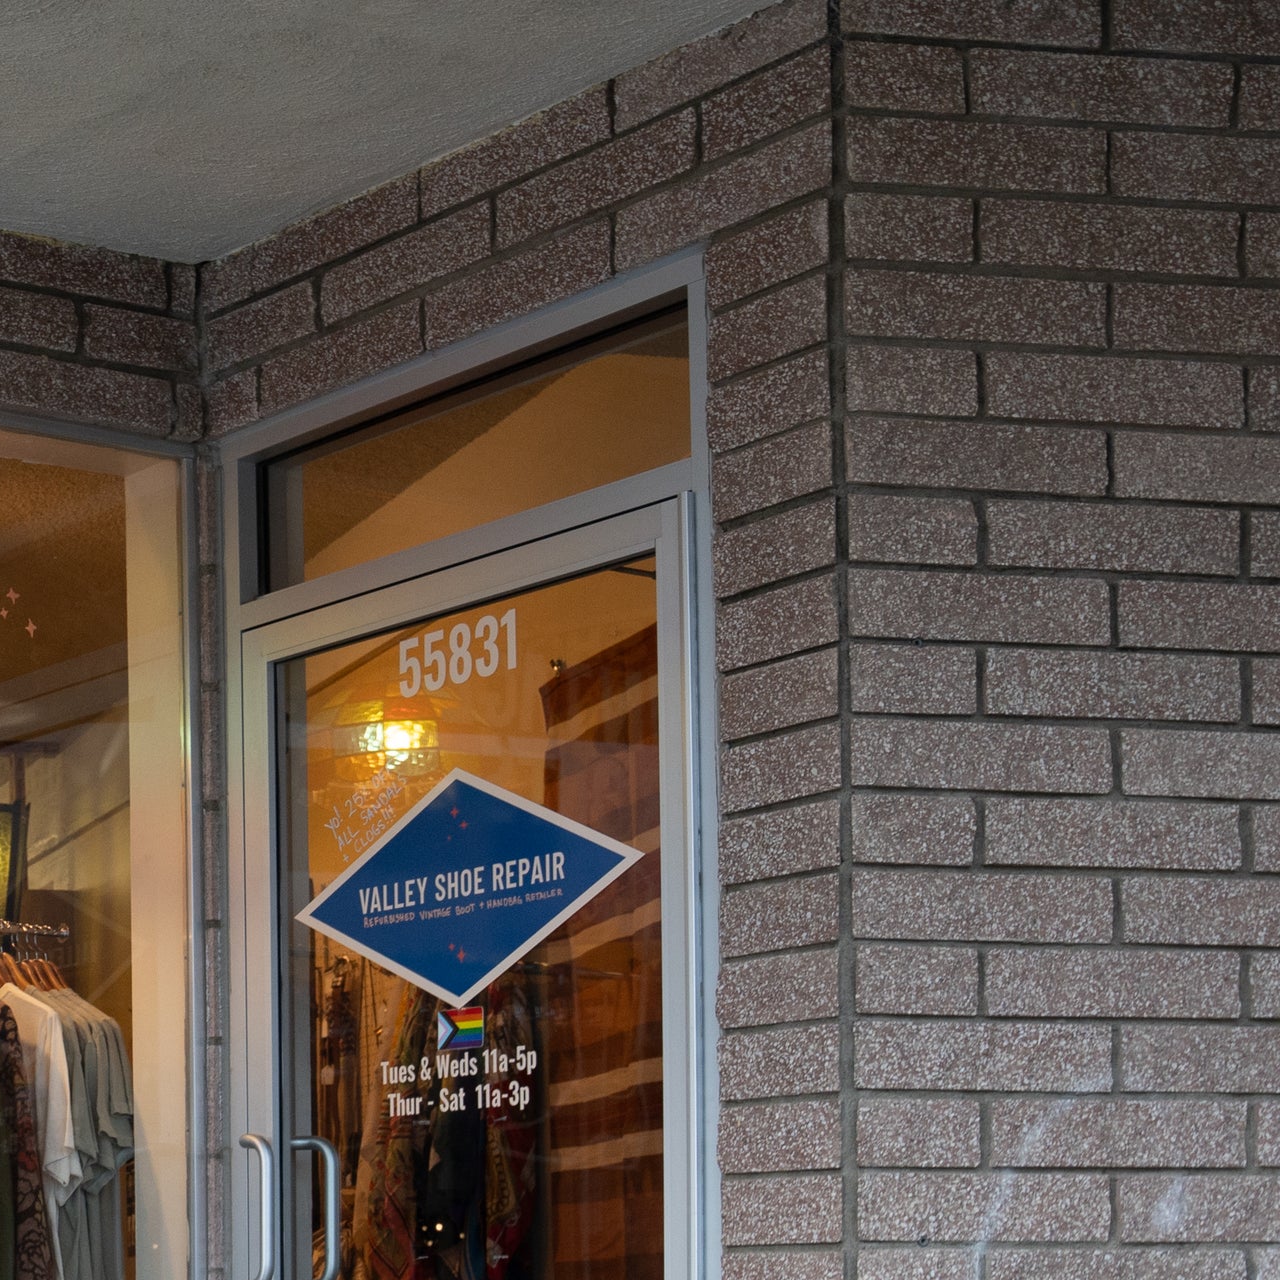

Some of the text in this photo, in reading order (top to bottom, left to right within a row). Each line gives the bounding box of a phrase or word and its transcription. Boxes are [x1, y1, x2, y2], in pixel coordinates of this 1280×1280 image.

[399, 608, 517, 698] 55831
[337, 826, 359, 852] ALL
[359, 852, 566, 914] VALLEY SHOE REPAIR
[363, 912, 416, 929] REFURBISHED
[419, 906, 453, 920] VINTAGE
[455, 903, 476, 916] BOOT
[486, 896, 524, 910] HANDBAG
[525, 888, 564, 904] RETAILER
[380, 1045, 537, 1086] Tues & Weds 11a-5p
[387, 1093, 423, 1117] Thur
[439, 1087, 467, 1113] Sat
[475, 1080, 530, 1111] 11a-3p
